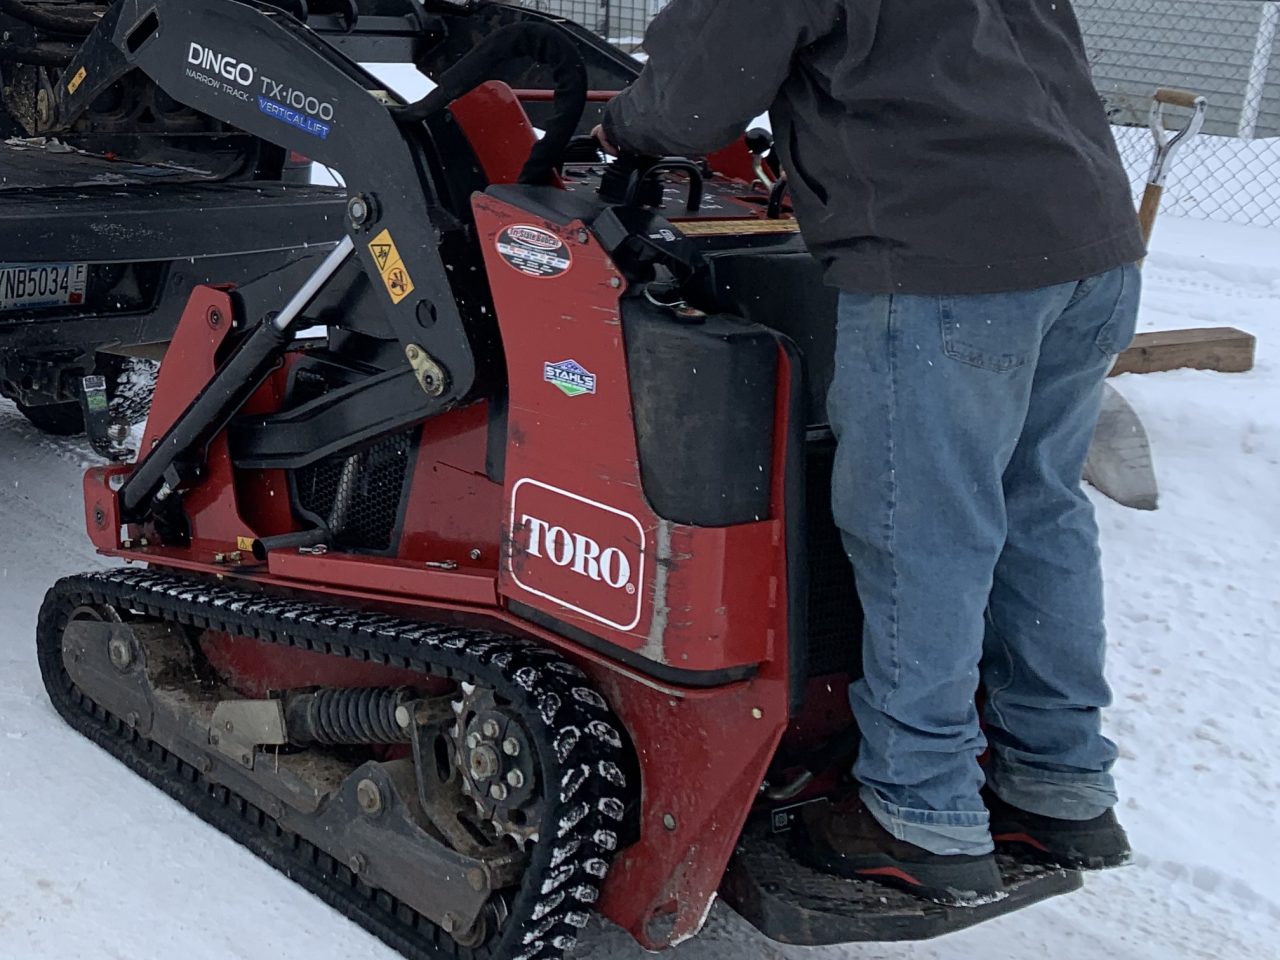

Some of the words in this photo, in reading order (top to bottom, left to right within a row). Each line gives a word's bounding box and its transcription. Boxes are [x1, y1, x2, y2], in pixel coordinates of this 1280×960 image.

[185, 67, 221, 89] NARROW
[259, 99, 306, 128] VERTICAL
[307, 116, 330, 137] LIFT
[76, 265, 84, 280] F
[546, 366, 593, 386] STAHL'S
[521, 514, 631, 589] TORO
